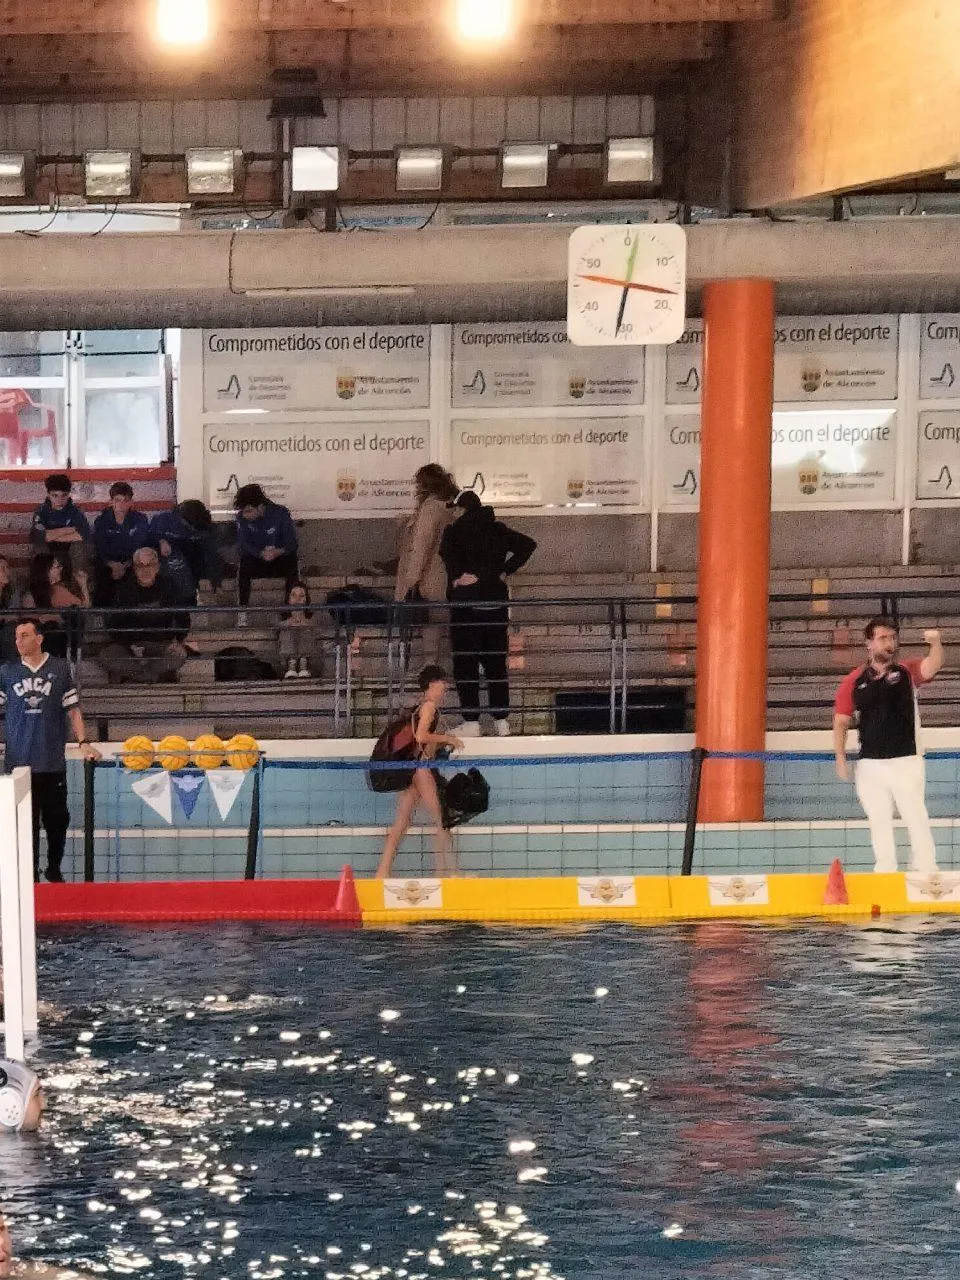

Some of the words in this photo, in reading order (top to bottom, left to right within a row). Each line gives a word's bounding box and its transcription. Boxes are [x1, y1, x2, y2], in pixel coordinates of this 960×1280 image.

[623, 236, 632, 246] 0
[586, 258, 601, 268] 50
[656, 257, 668, 267] 10
[585, 301, 599, 311] 40
[654, 300, 668, 310] 20
[461, 330, 549, 347] Comprometidos
[790, 329, 815, 342] con
[818, 324, 832, 341] el
[834, 324, 890, 345] deporte
[209, 333, 321, 355] Comprometidos
[325, 335, 350, 351] con
[352, 332, 366, 350] el
[369, 332, 424, 353] deporte
[460, 431, 548, 447] Comprometidos
[551, 432, 571, 444] con
[573, 428, 583, 443] el
[586, 429, 628, 445] deporte
[788, 427, 813, 443] con
[817, 422, 829, 441] el
[833, 423, 889, 446] deporte
[209, 434, 321, 456] Comprometidos
[325, 436, 350, 452] con
[353, 433, 366, 451] el
[369, 433, 424, 454] deporte
